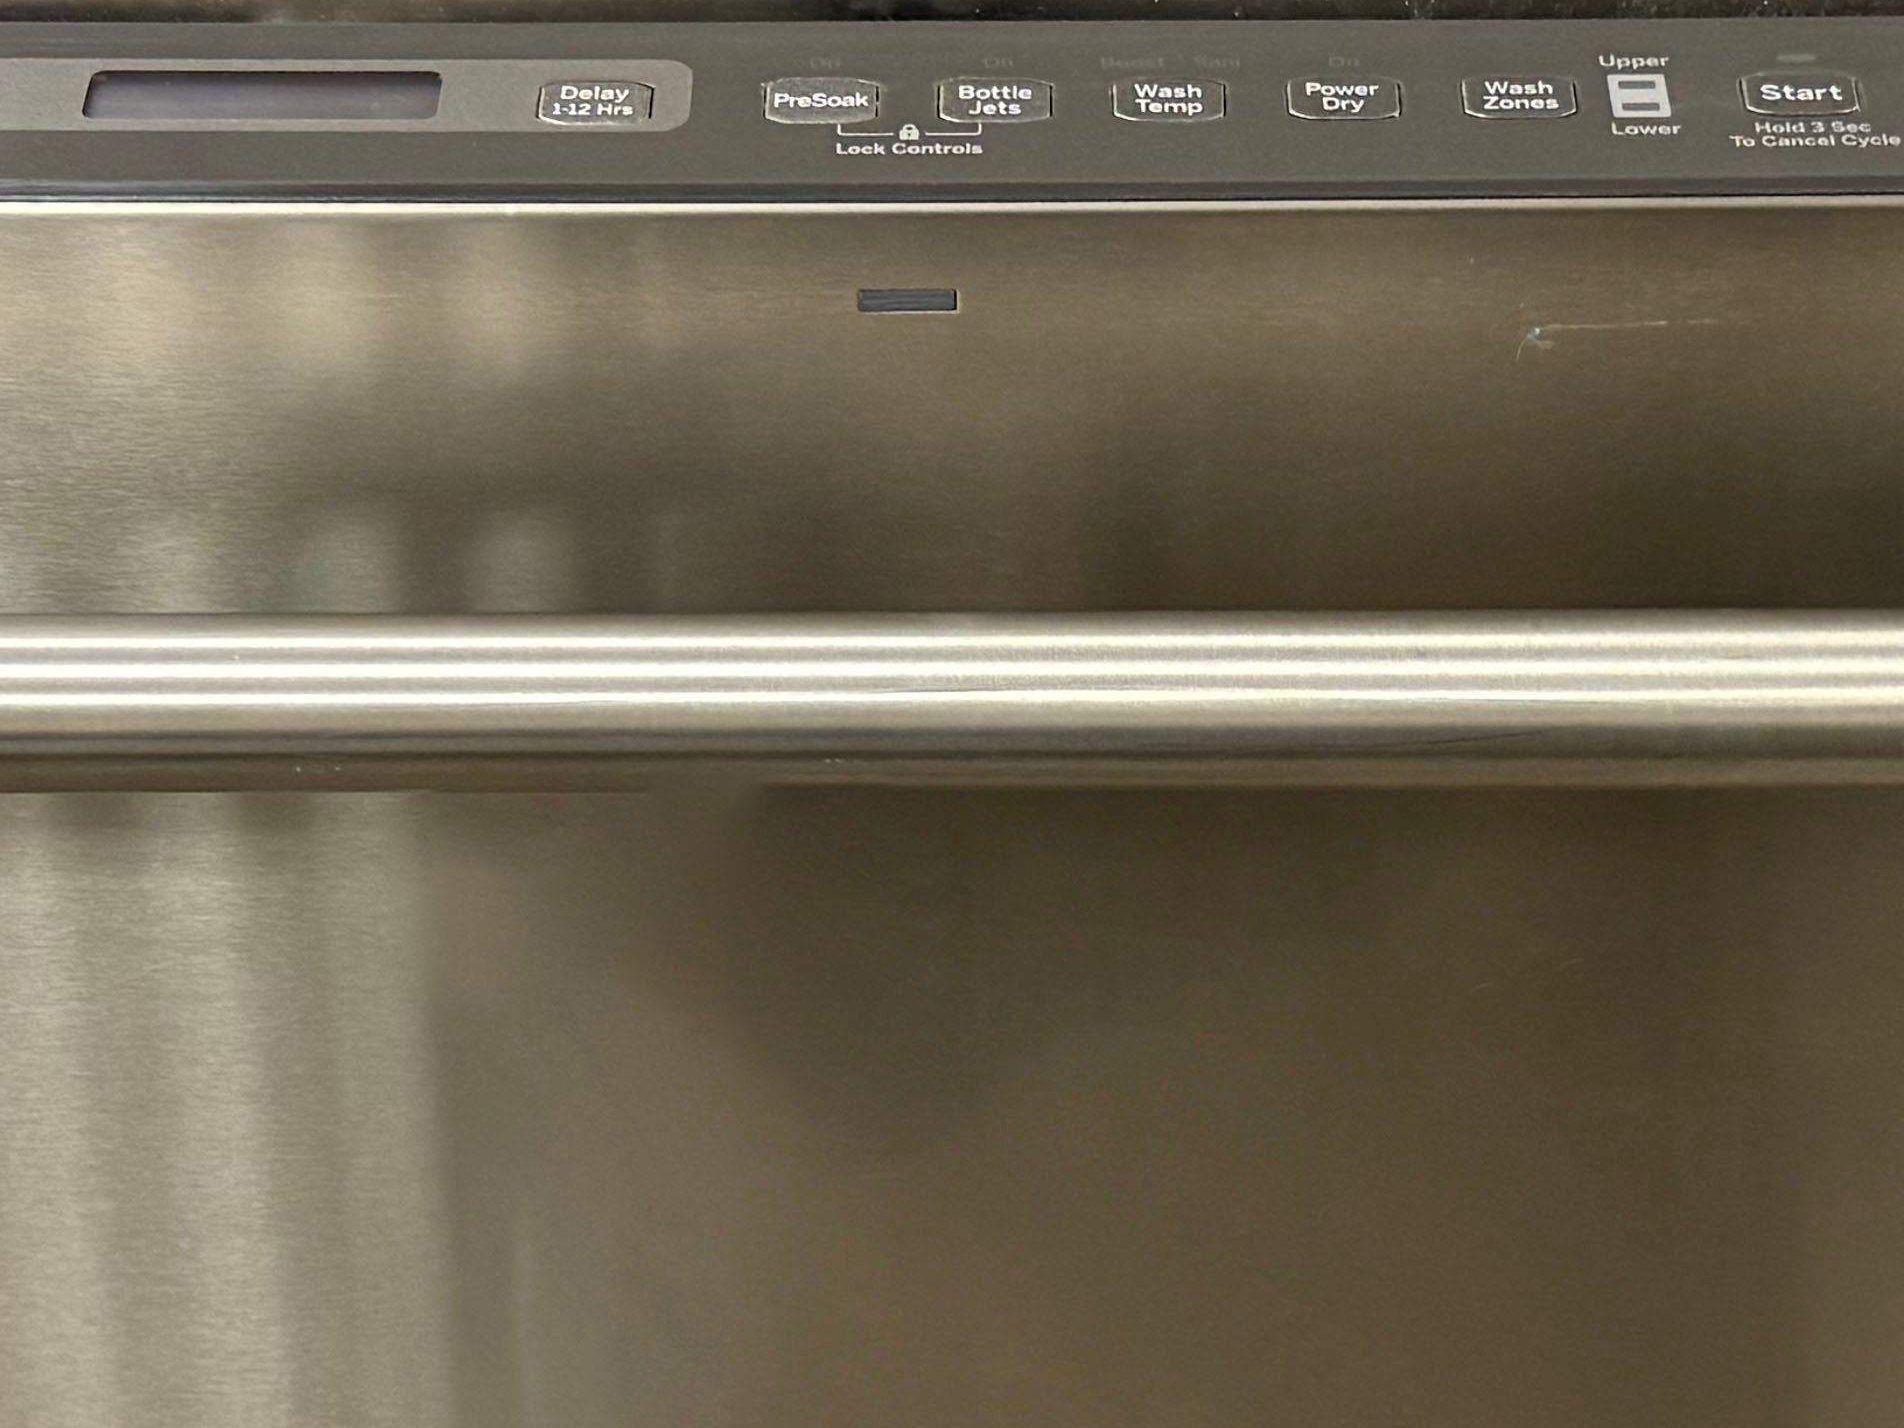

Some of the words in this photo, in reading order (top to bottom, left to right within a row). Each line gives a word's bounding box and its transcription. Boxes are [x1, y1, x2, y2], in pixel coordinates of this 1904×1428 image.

[1598, 54, 1670, 70] Upper
[560, 85, 630, 103] Delay
[958, 85, 1033, 100] Bottle
[1134, 83, 1203, 99] Wash
[1305, 81, 1379, 97] Power
[1484, 80, 1553, 95] Wash
[1760, 84, 1843, 101] Start
[773, 91, 869, 108] PreSoak
[1135, 99, 1204, 116] Temp
[1322, 97, 1365, 113] Dry
[1483, 96, 1560, 110] Zones
[552, 103, 591, 116] 1-12
[597, 103, 633, 116] Hrs
[968, 100, 1022, 116] Jets
[1611, 122, 1682, 136] Lower
[1754, 121, 1805, 134] Hold
[1812, 122, 1825, 133] 3
[1831, 121, 1872, 133] Sec
[836, 142, 885, 155] Lock
[892, 142, 984, 155] Controls
[1729, 134, 1755, 147] To
[1761, 133, 1836, 147] Cancel
[1841, 133, 1902, 148] Cycle
